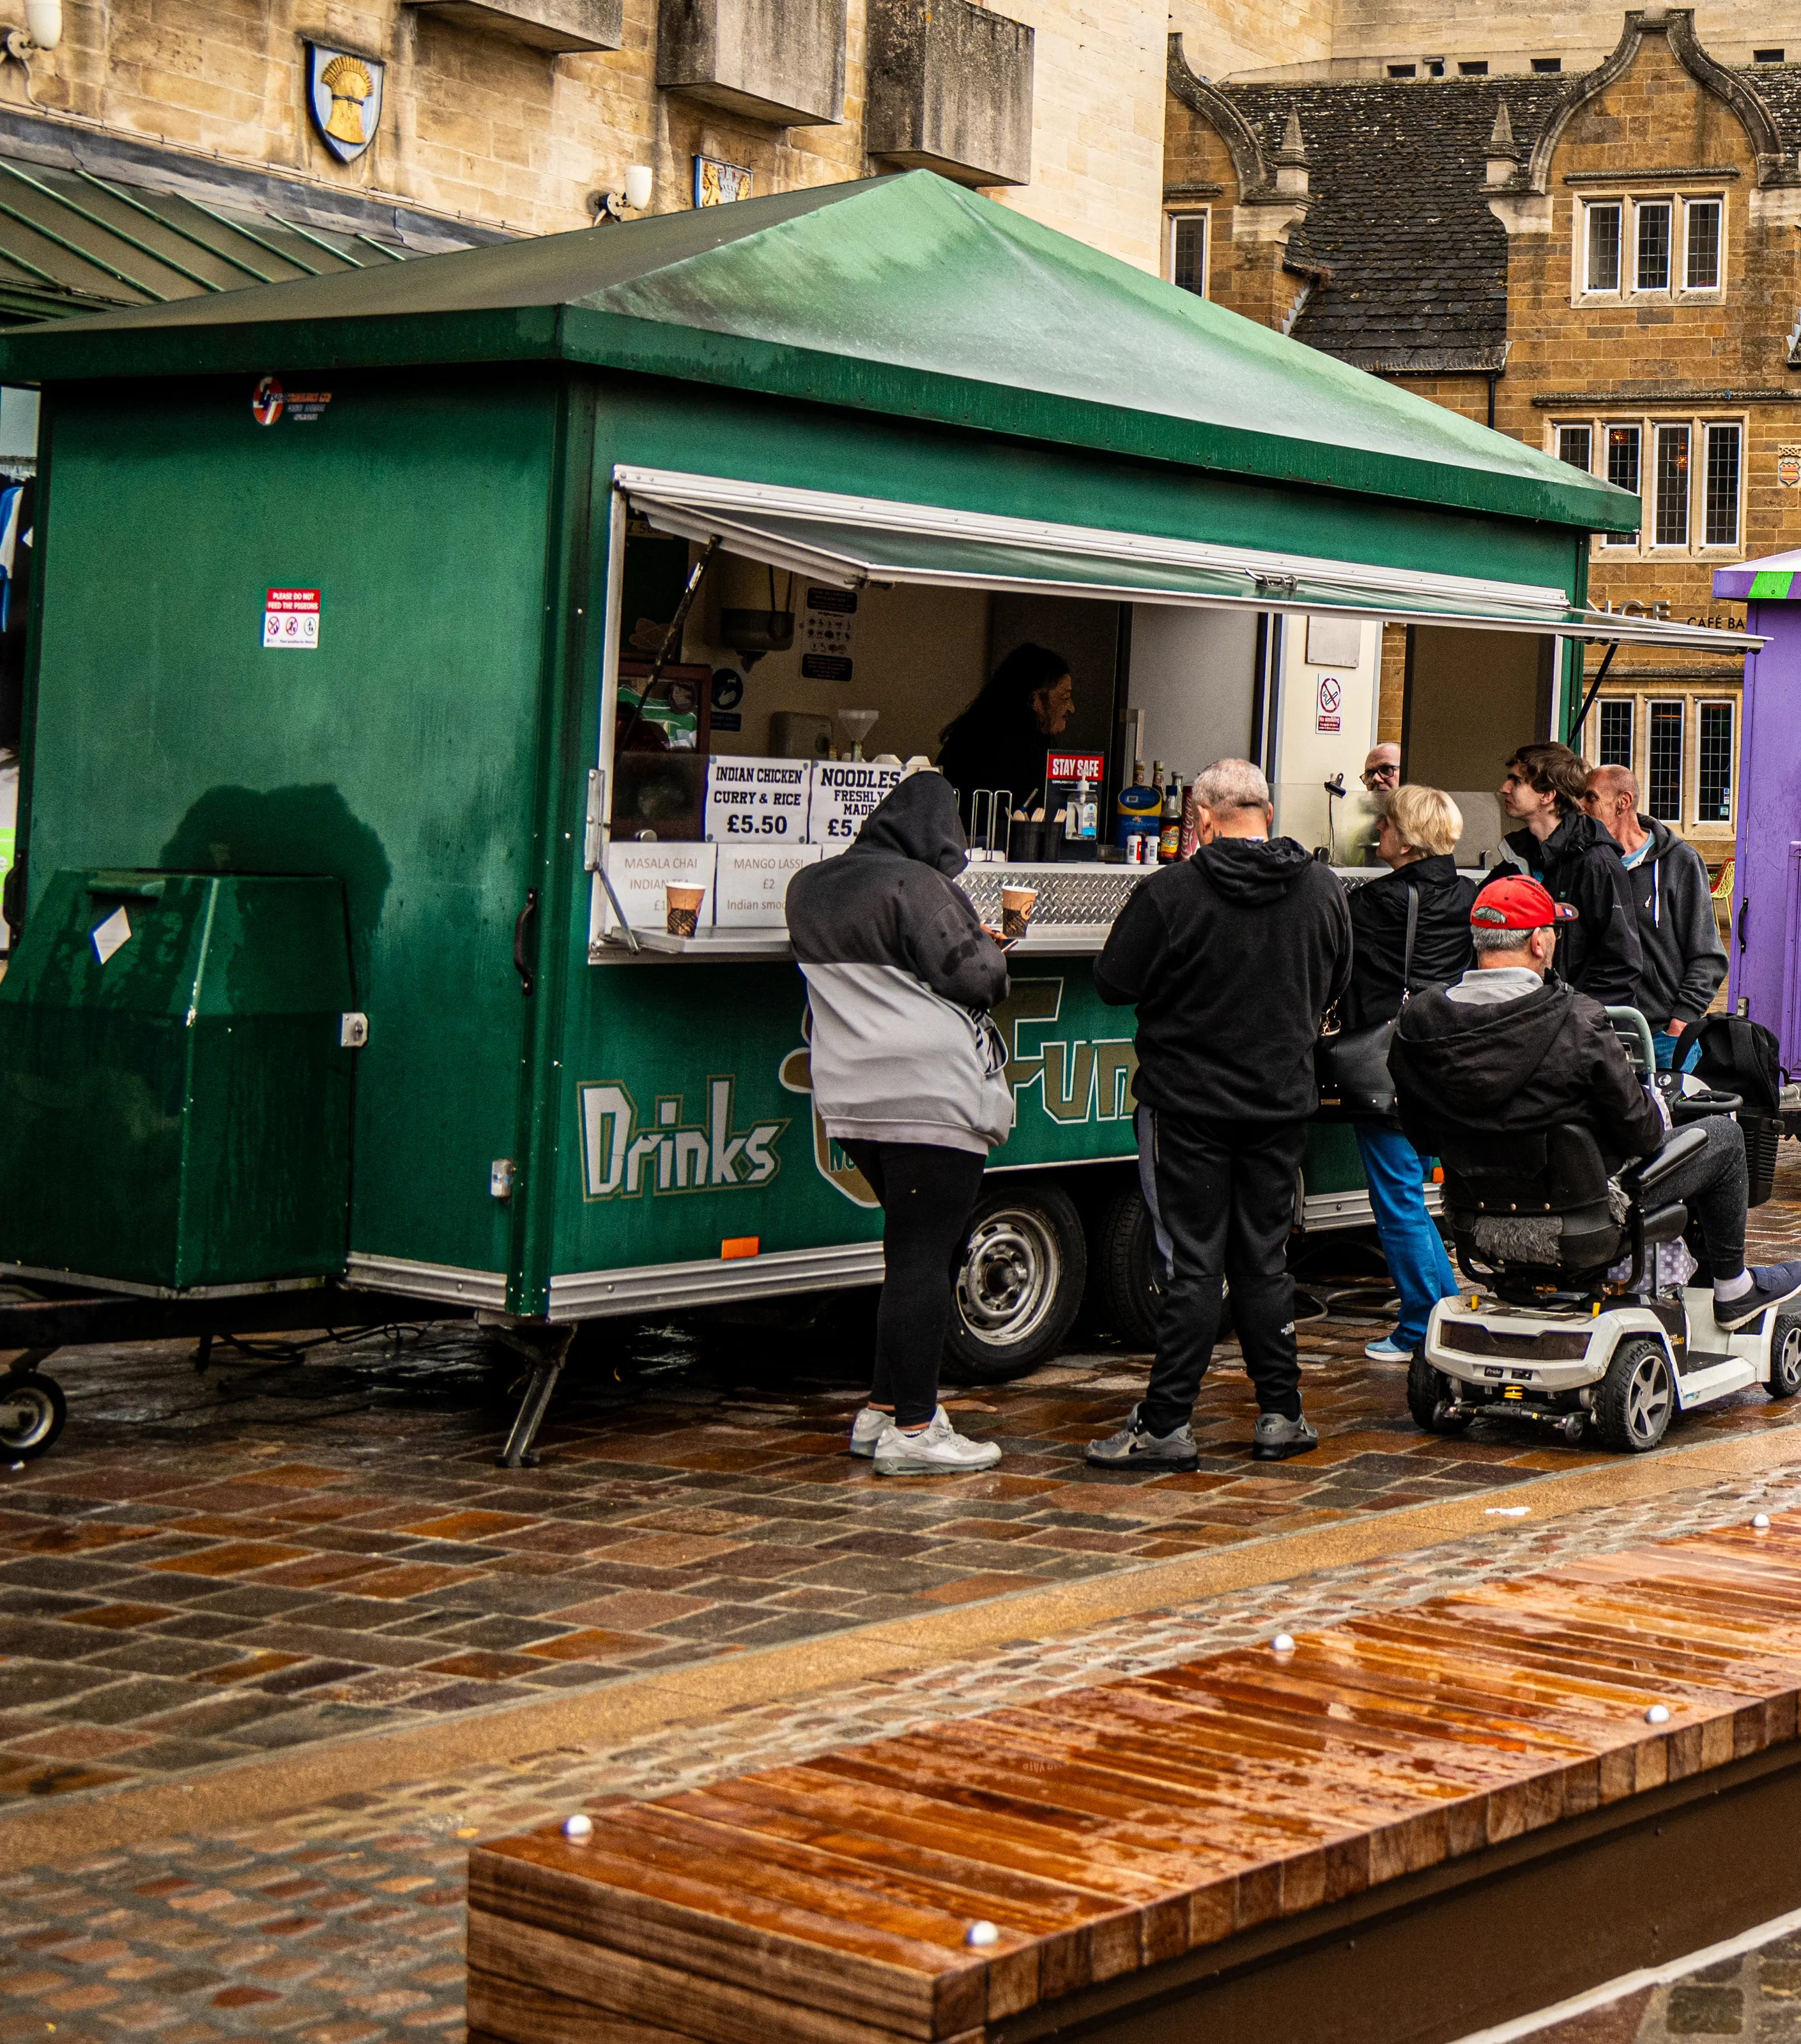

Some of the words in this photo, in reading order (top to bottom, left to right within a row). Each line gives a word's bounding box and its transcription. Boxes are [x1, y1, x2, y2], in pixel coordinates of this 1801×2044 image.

[268, 601, 282, 609] FEED
[1687, 615, 1721, 629] CAFÉ
[1728, 618, 1745, 630] BA
[1052, 758, 1076, 776] STAY
[1077, 759, 1100, 777] SAFE
[716, 766, 755, 782] INDIAN
[757, 768, 802, 784] CHICKEN
[821, 768, 901, 788] NOODLES
[714, 791, 756, 804] CURRY
[759, 793, 768, 804] &
[773, 793, 802, 805] RICE
[834, 790, 884, 804] FRESHLY
[843, 804, 875, 815] MADE
[727, 814, 787, 834] £5.50
[827, 818, 864, 837] £5.
[624, 858, 670, 869] MASALA
[673, 858, 698, 869] CHAI
[734, 858, 776, 869] MANGO
[778, 858, 804, 869] LASSI
[630, 879, 668, 890] INDIAN
[762, 878, 775, 889] £2
[727, 899, 758, 910] Indian
[761, 901, 786, 910] smoo
[578, 1074, 790, 1202] Drinks
